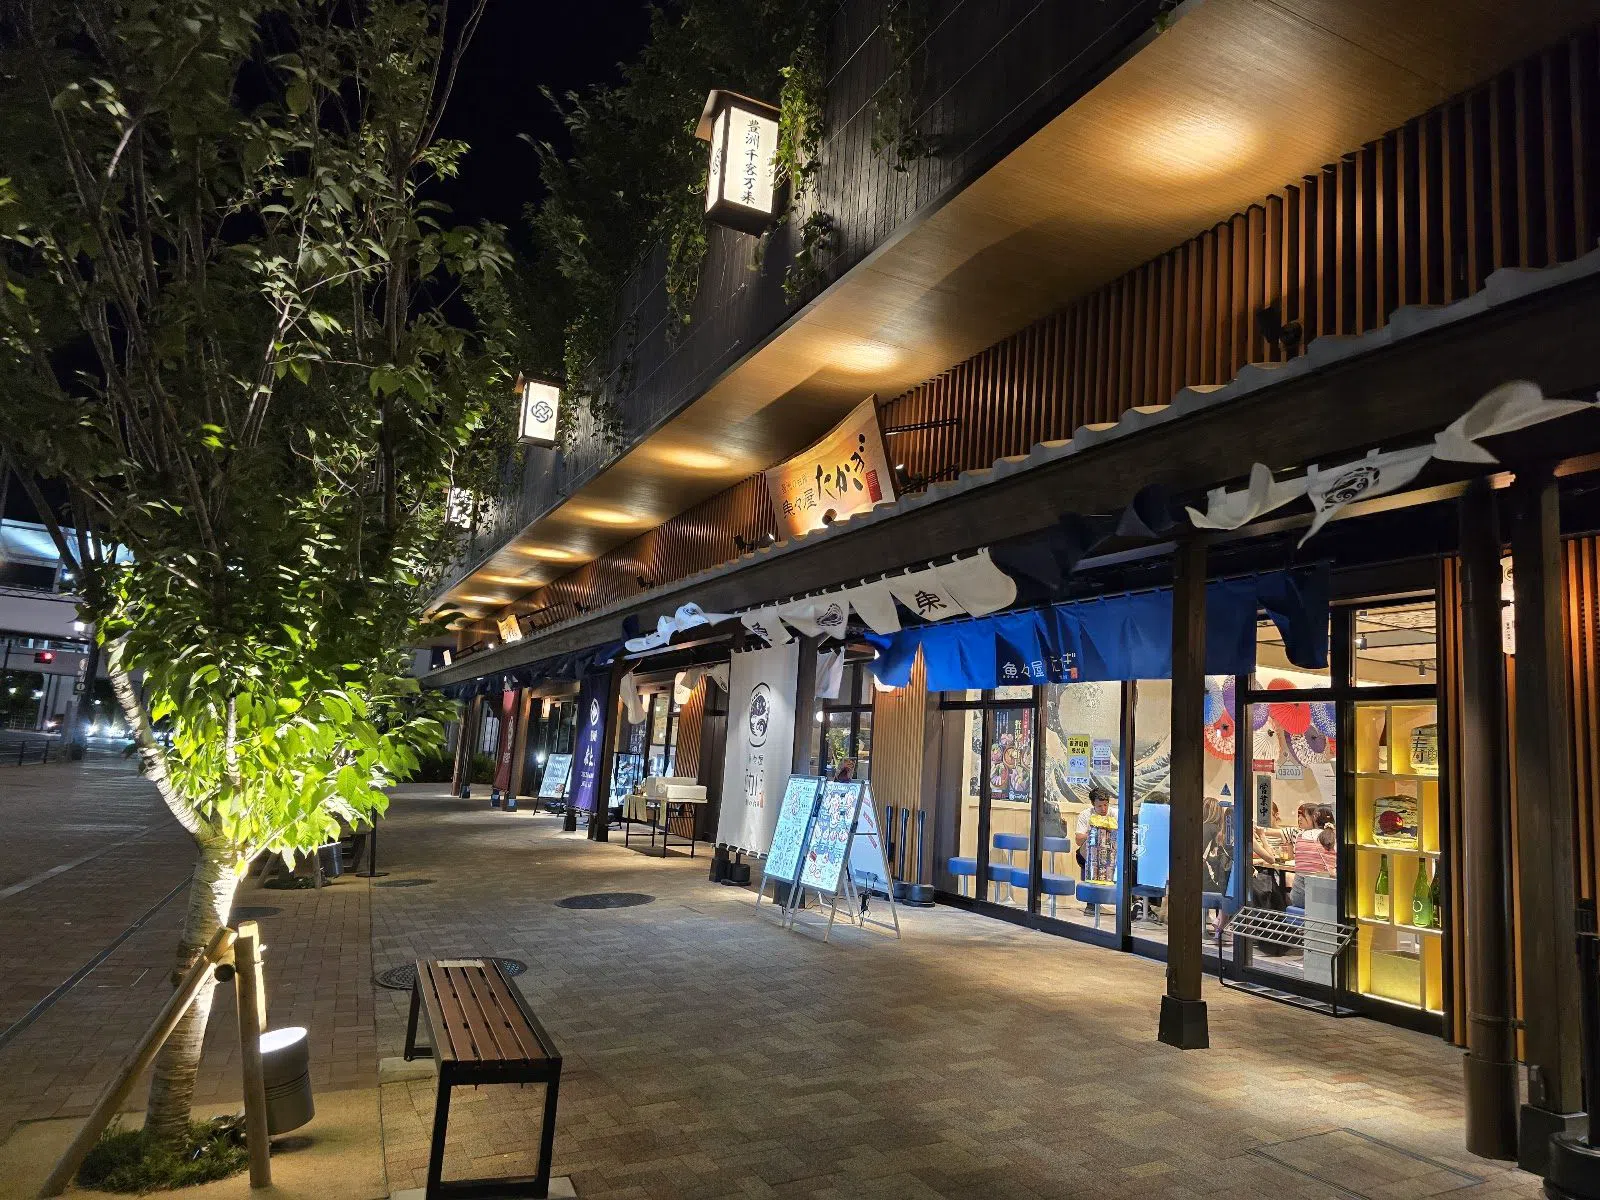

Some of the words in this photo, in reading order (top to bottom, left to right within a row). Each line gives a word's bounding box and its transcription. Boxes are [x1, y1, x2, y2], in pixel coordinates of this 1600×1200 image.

[741, 119, 761, 205] 豊洲千客万来
[915, 590, 947, 615] 魚
[1002, 660, 1045, 677] 魚々屋
[1259, 782, 1269, 817] 営業中
